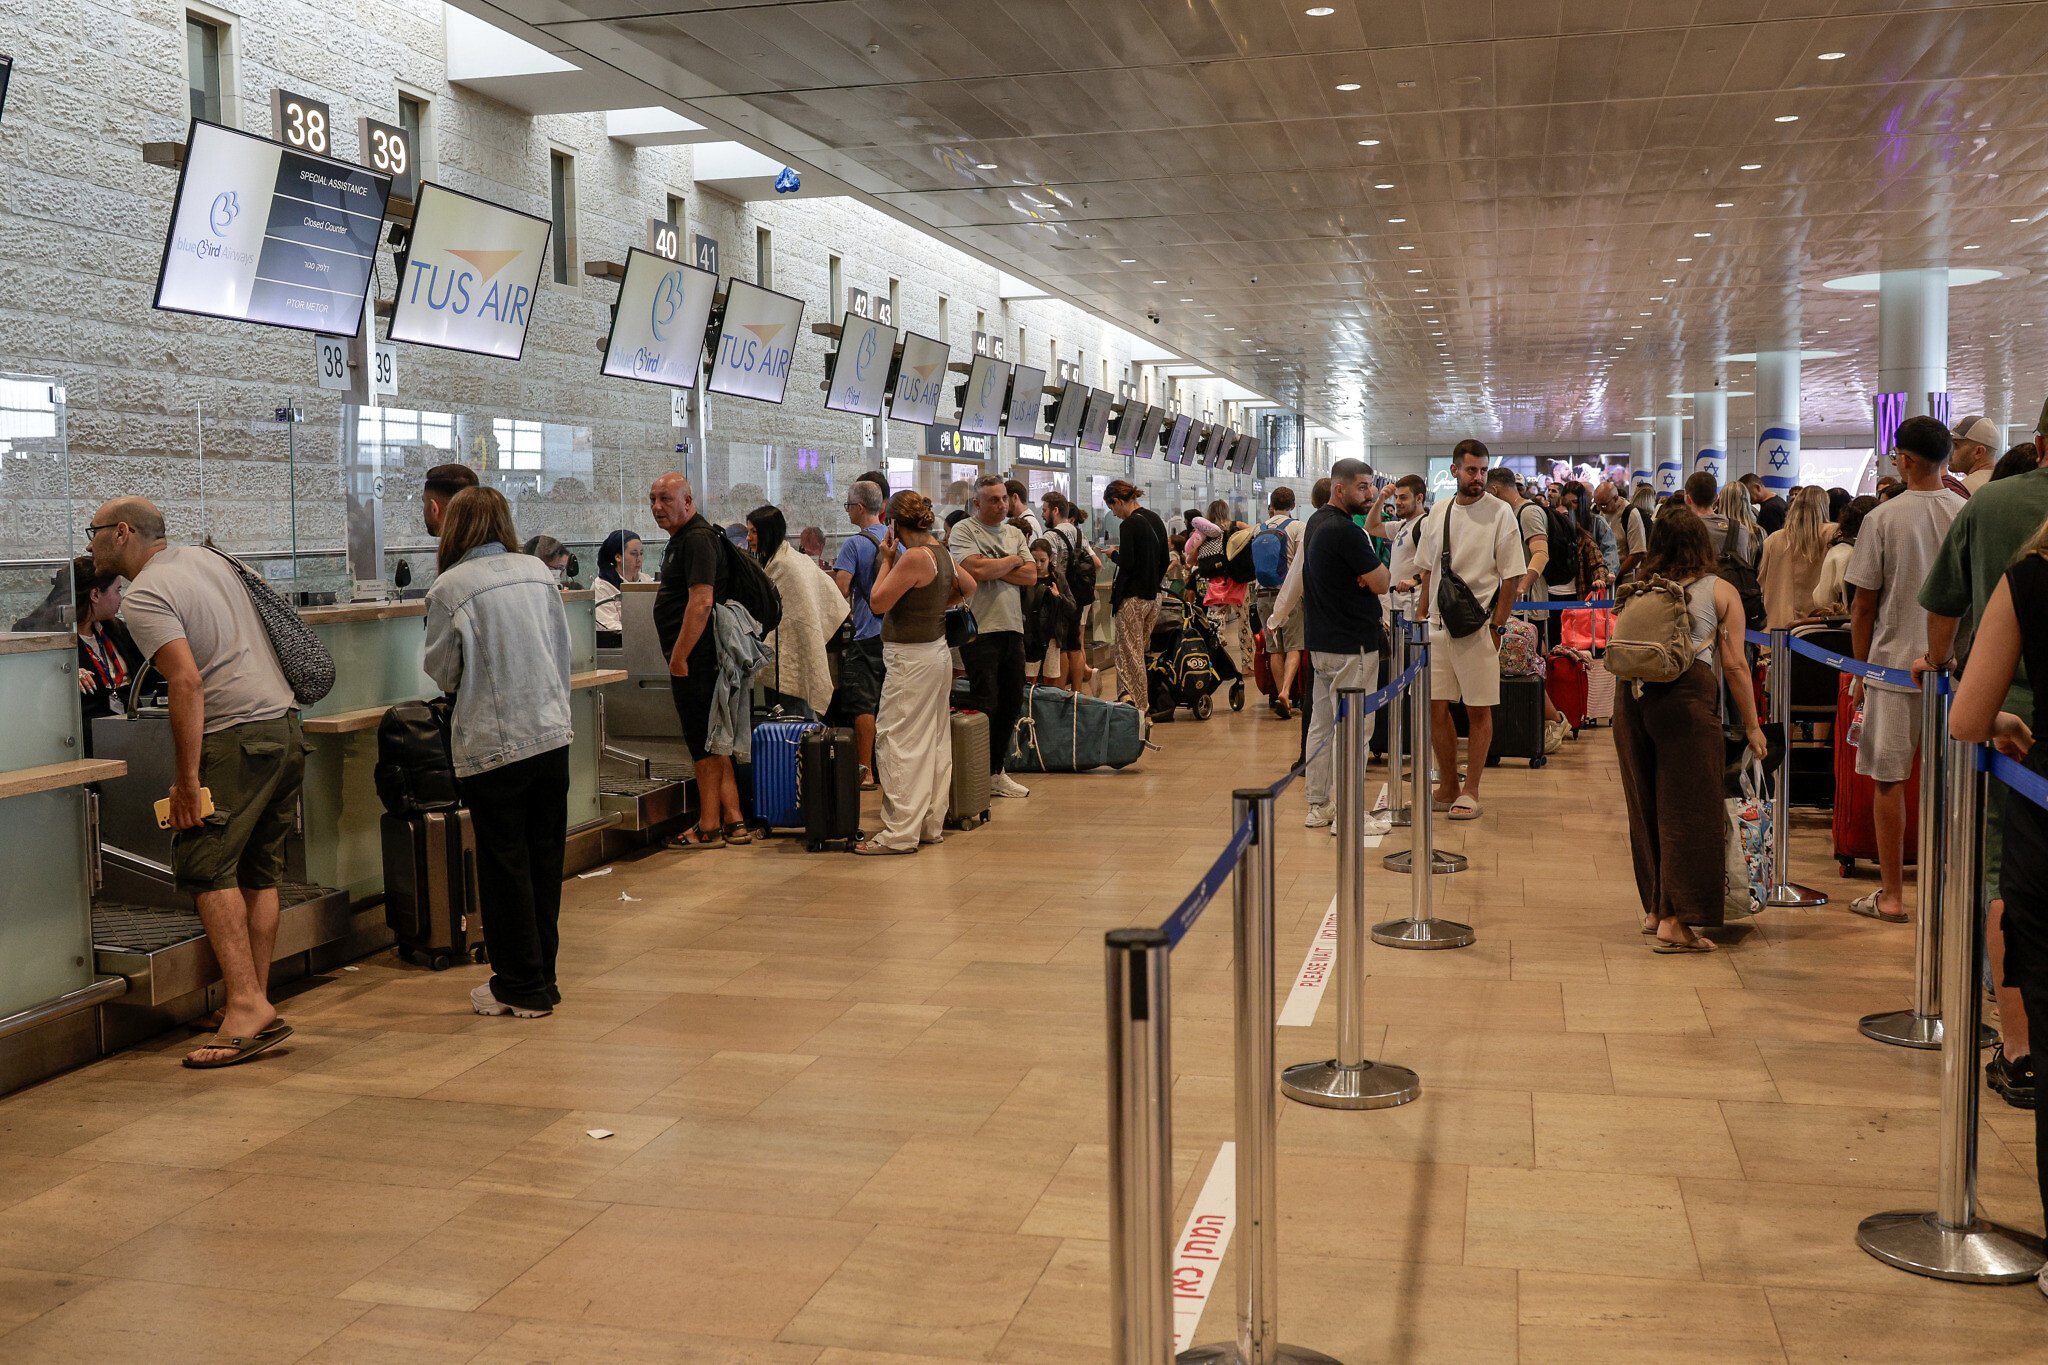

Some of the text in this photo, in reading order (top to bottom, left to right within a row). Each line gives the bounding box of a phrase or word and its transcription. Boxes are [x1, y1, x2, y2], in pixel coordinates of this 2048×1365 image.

[286, 102, 326, 153] 38
[372, 129, 406, 174] 39
[300, 170, 368, 196] SPECIAL ASSISTANCE
[303, 216, 348, 234] Closed Counter
[656, 228, 677, 260] 40
[699, 243, 716, 272] 41
[410, 260, 529, 326] TUS AIR
[854, 290, 867, 318] 42
[879, 302, 891, 326] 43
[720, 334, 790, 379] TUS AIR
[976, 336, 986, 355] 44
[994, 340, 1003, 360] 45
[323, 346, 344, 379] 38
[375, 351, 392, 383] 39
[898, 374, 940, 406] TUS AIR
[675, 396, 685, 419] 40
[1300, 947, 1334, 987] PLEASE WAIT
[1172, 1214, 1226, 1299] המתן כאן
